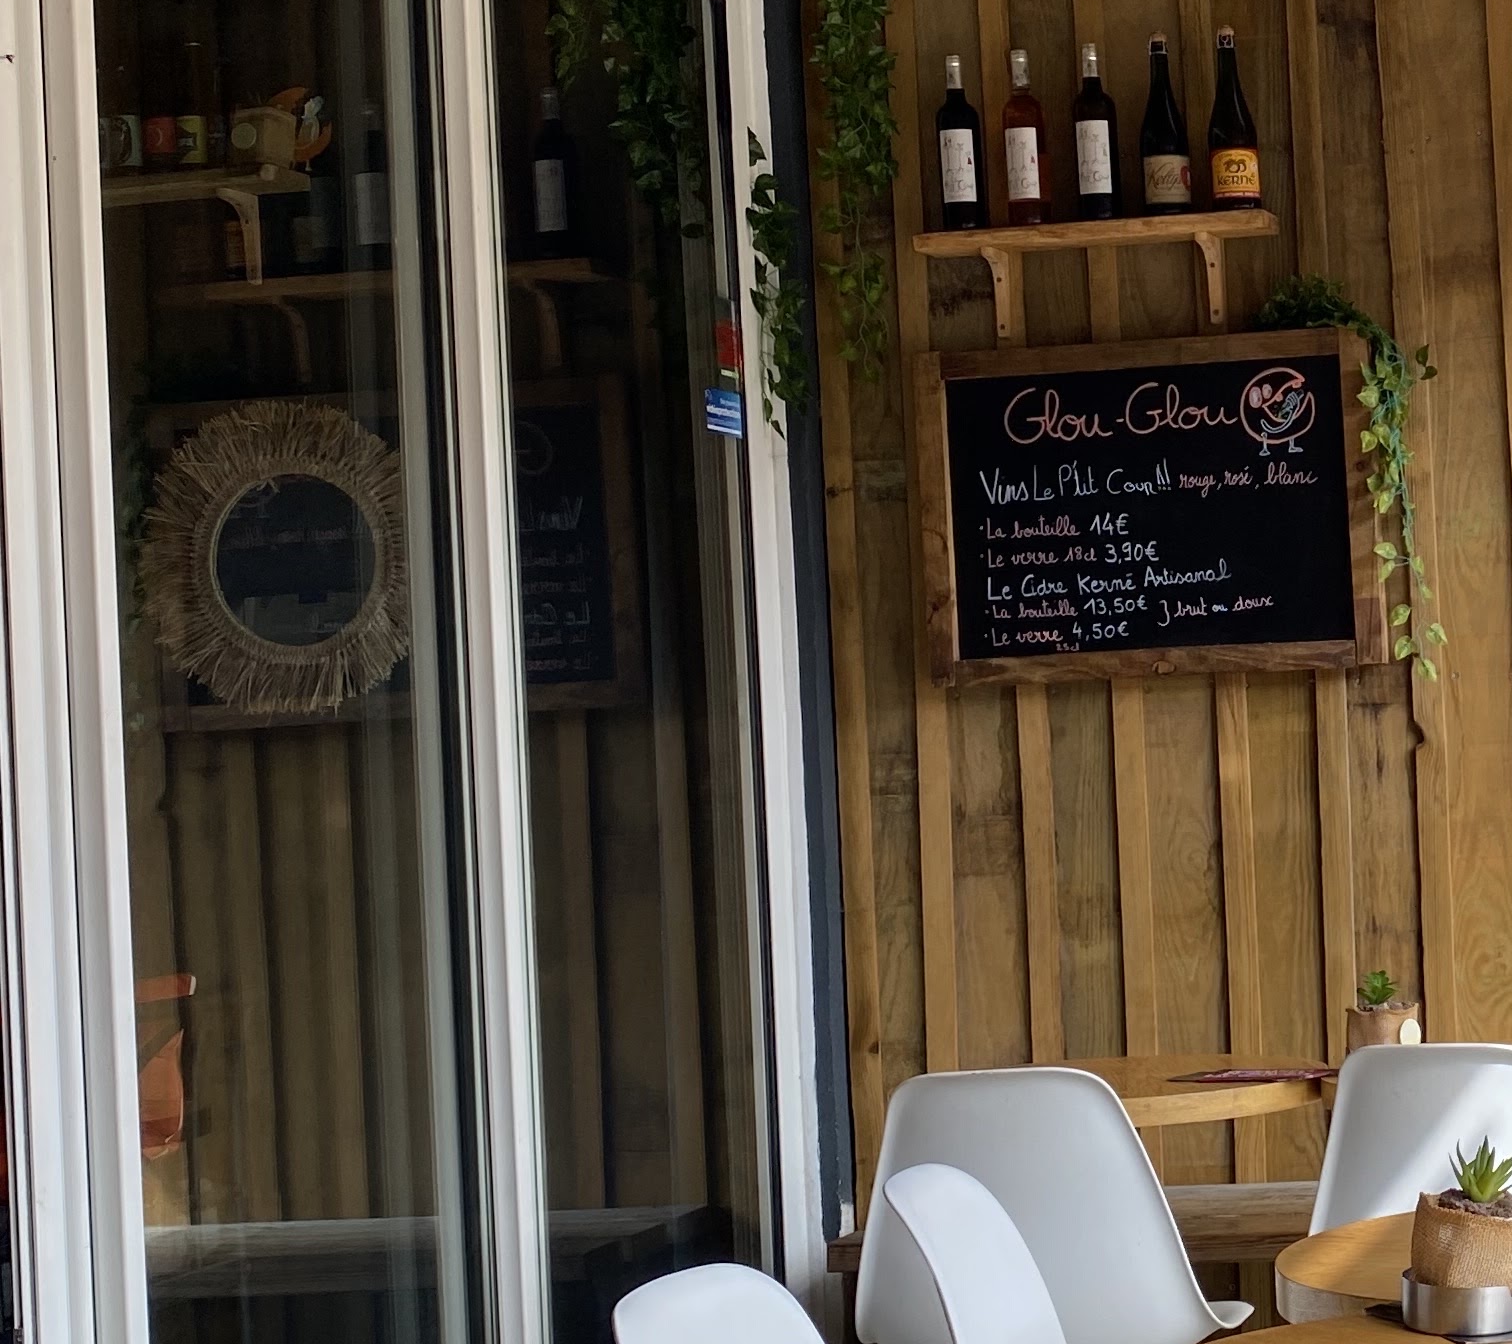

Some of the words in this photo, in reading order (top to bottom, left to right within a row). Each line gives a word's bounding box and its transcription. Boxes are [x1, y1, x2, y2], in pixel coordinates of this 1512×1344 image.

[980, 465, 1029, 504] Vins
[1033, 464, 1055, 500] Le
[1264, 462, 1318, 485] blanc
[986, 517, 1006, 539] La
[1011, 515, 1080, 539] bouteille
[988, 548, 1005, 568] Le
[1011, 551, 1059, 565] verre
[987, 576, 1013, 601] Le
[1021, 574, 1068, 597] Cidre
[1144, 558, 1232, 588] Artisanal
[992, 604, 1011, 618] La
[1017, 598, 1078, 618] bouteille
[1232, 595, 1274, 611] doux
[992, 627, 1010, 646] Le
[1015, 628, 1063, 643] verre
